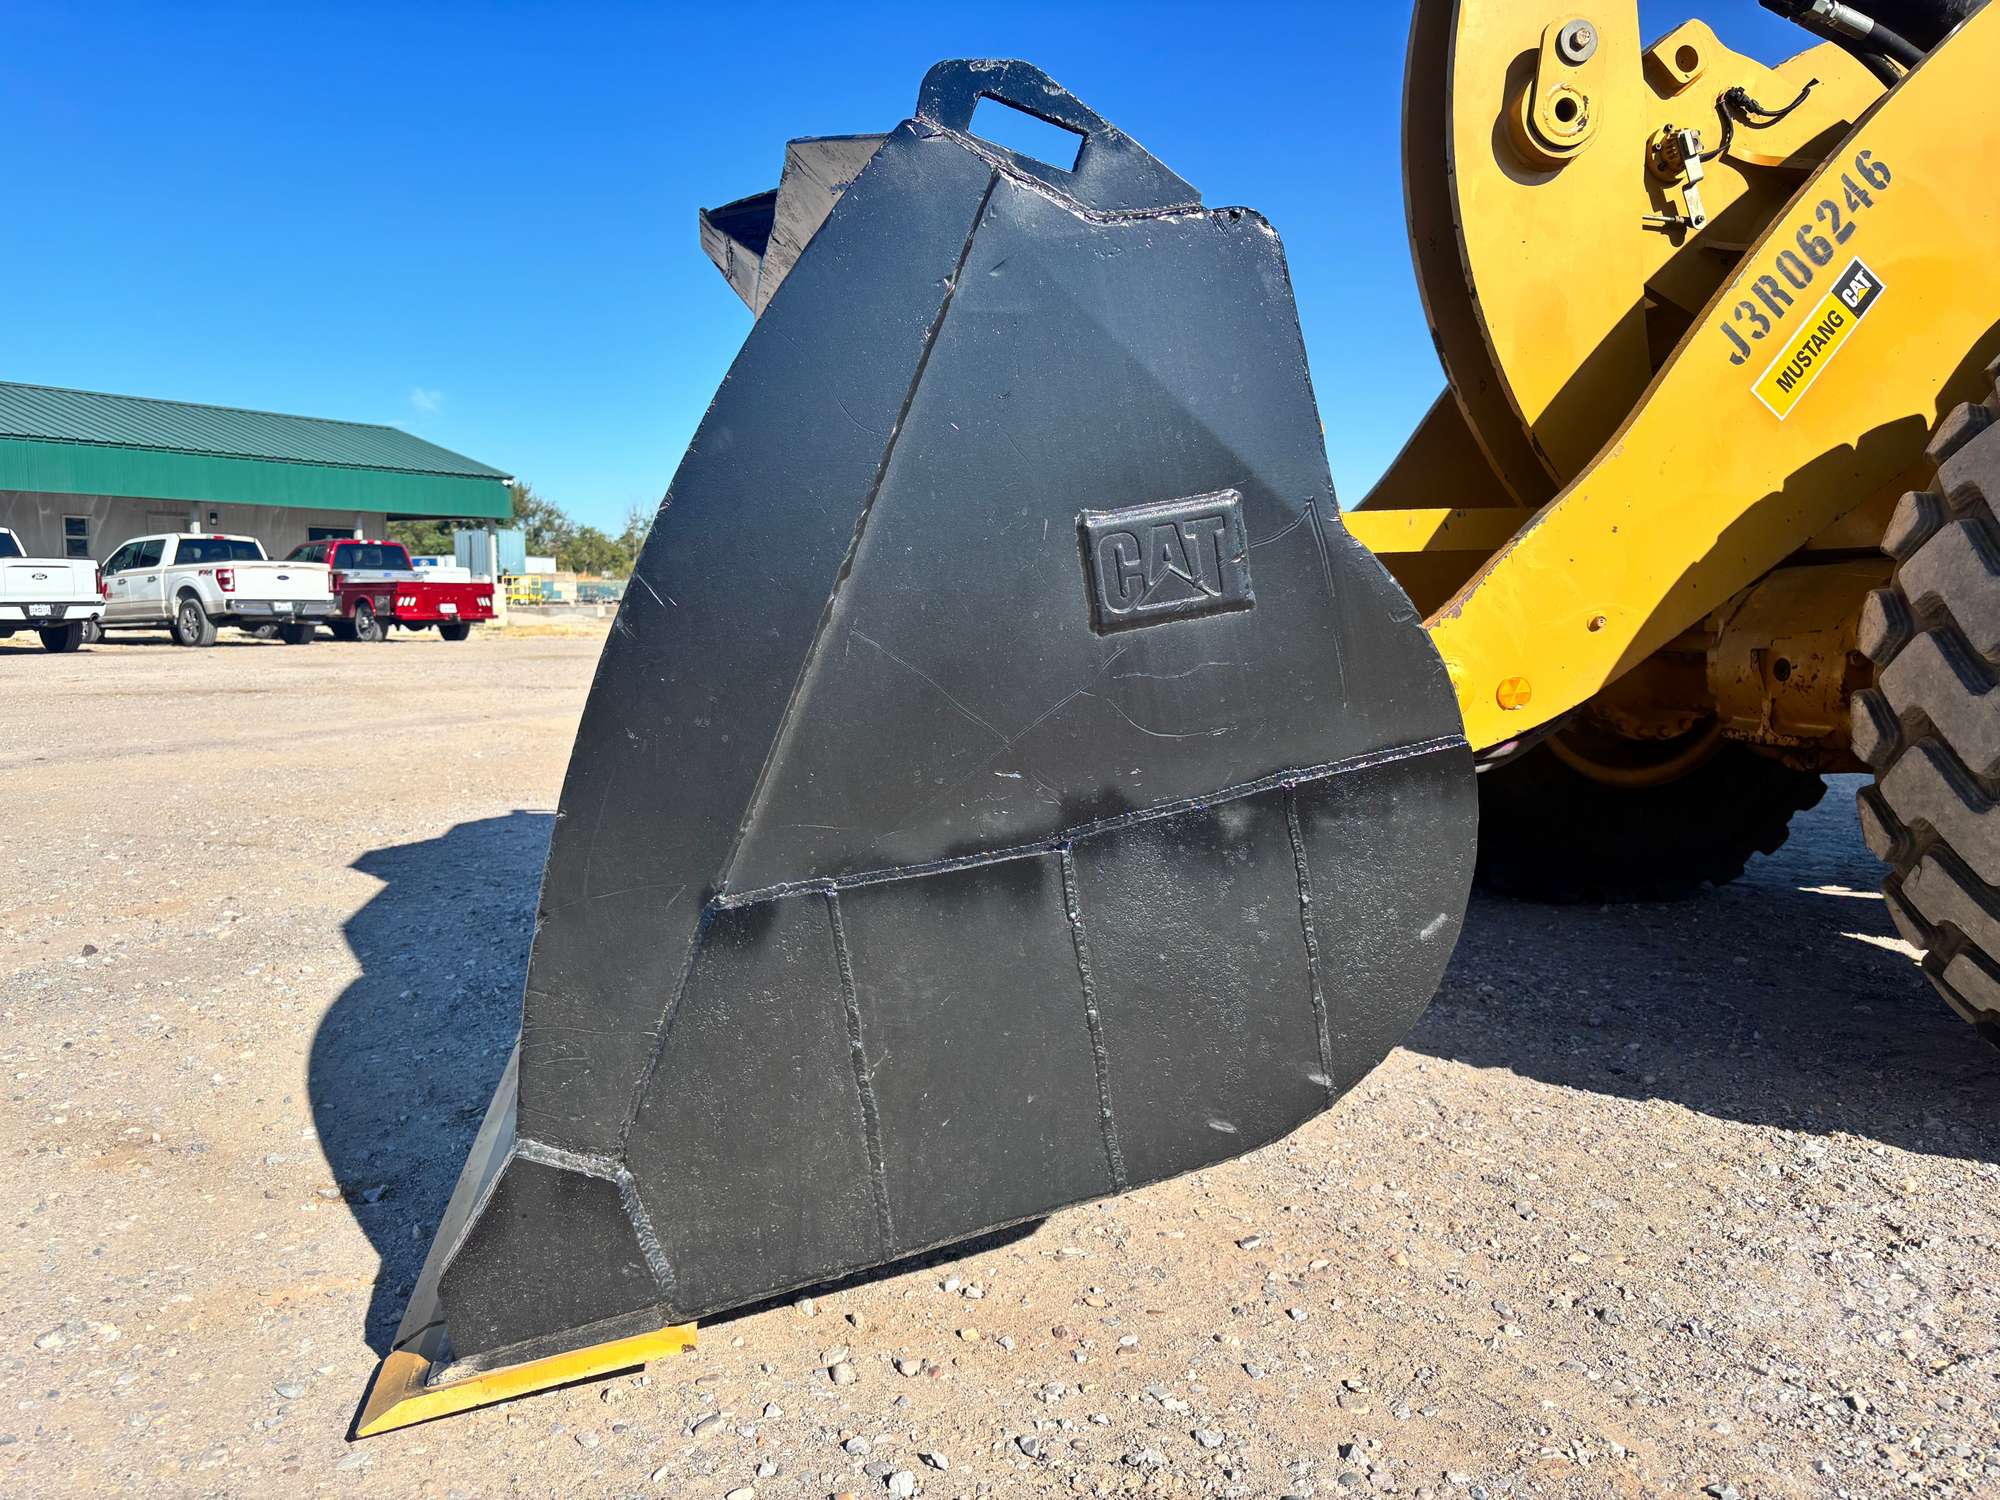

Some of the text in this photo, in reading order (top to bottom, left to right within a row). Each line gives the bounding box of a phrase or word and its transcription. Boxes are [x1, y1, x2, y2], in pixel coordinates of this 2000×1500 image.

[1720, 150, 1892, 366] J3R06246
[1775, 270, 1873, 393] MUSTANG CAT
[1098, 516, 1225, 614] CAT
